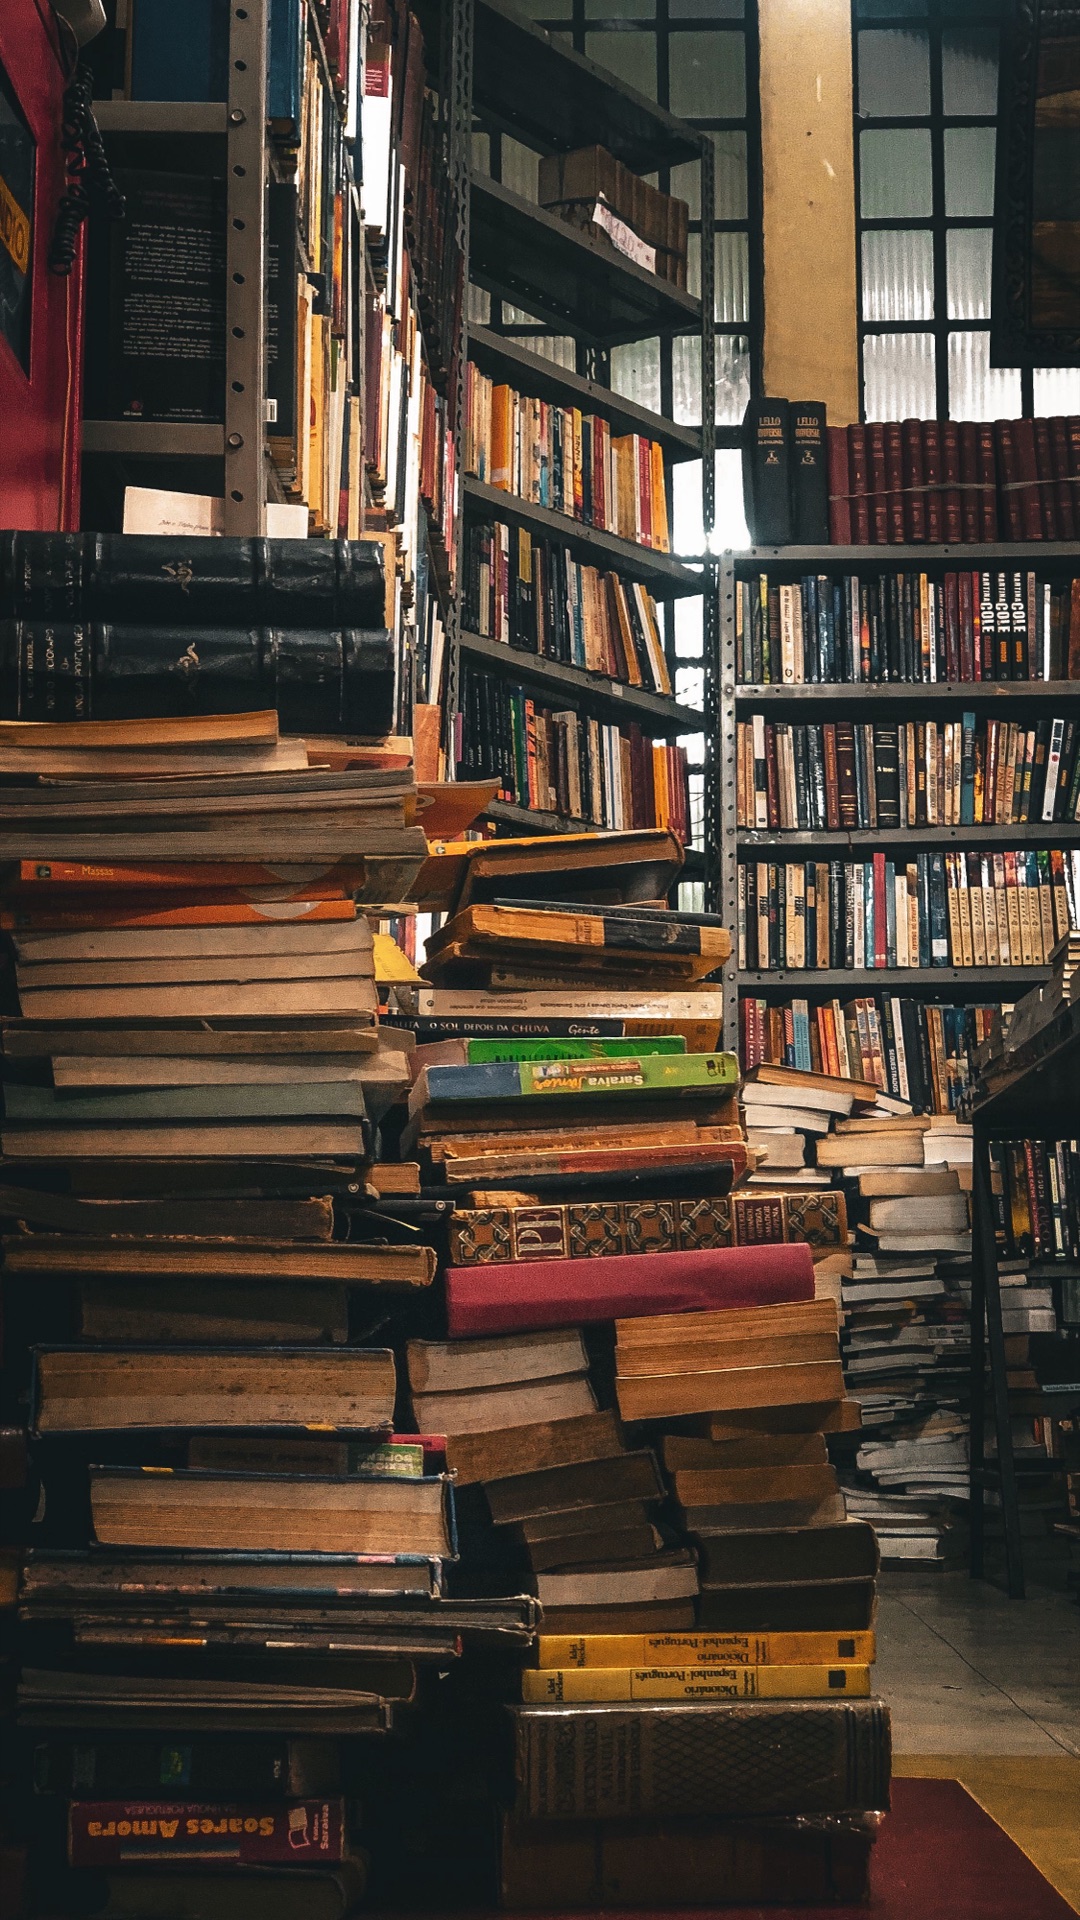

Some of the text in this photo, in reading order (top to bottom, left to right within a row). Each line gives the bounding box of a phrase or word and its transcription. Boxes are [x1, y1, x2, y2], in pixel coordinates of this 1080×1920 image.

[759, 416, 781, 426] LELLO
[796, 416, 819, 426] LELLO
[980, 572, 995, 633] MARTINA COLE
[995, 572, 1010, 633] MARTINA COLE
[1011, 572, 1026, 633] MARTINA COLE
[964, 727, 973, 744] ROBIN
[81, 865, 114, 876] Massas
[429, 1022, 551, 1034] O SOL DEPOIS DA CHUVA
[568, 1024, 601, 1035] Gente
[589, 1075, 644, 1086] Saraiva
[888, 1048, 899, 1093] SEQUESTRADOS
[755, 1207, 763, 1238] ORTEGA
[577, 1638, 585, 1667] Becker
[697, 1652, 750, 1664] Dicionário
[555, 1671, 563, 1701] Becker
[684, 1685, 738, 1696] Dicionário
[88, 1816, 275, 1839] Soares Amora
[320, 1803, 329, 1850] Saraiva
